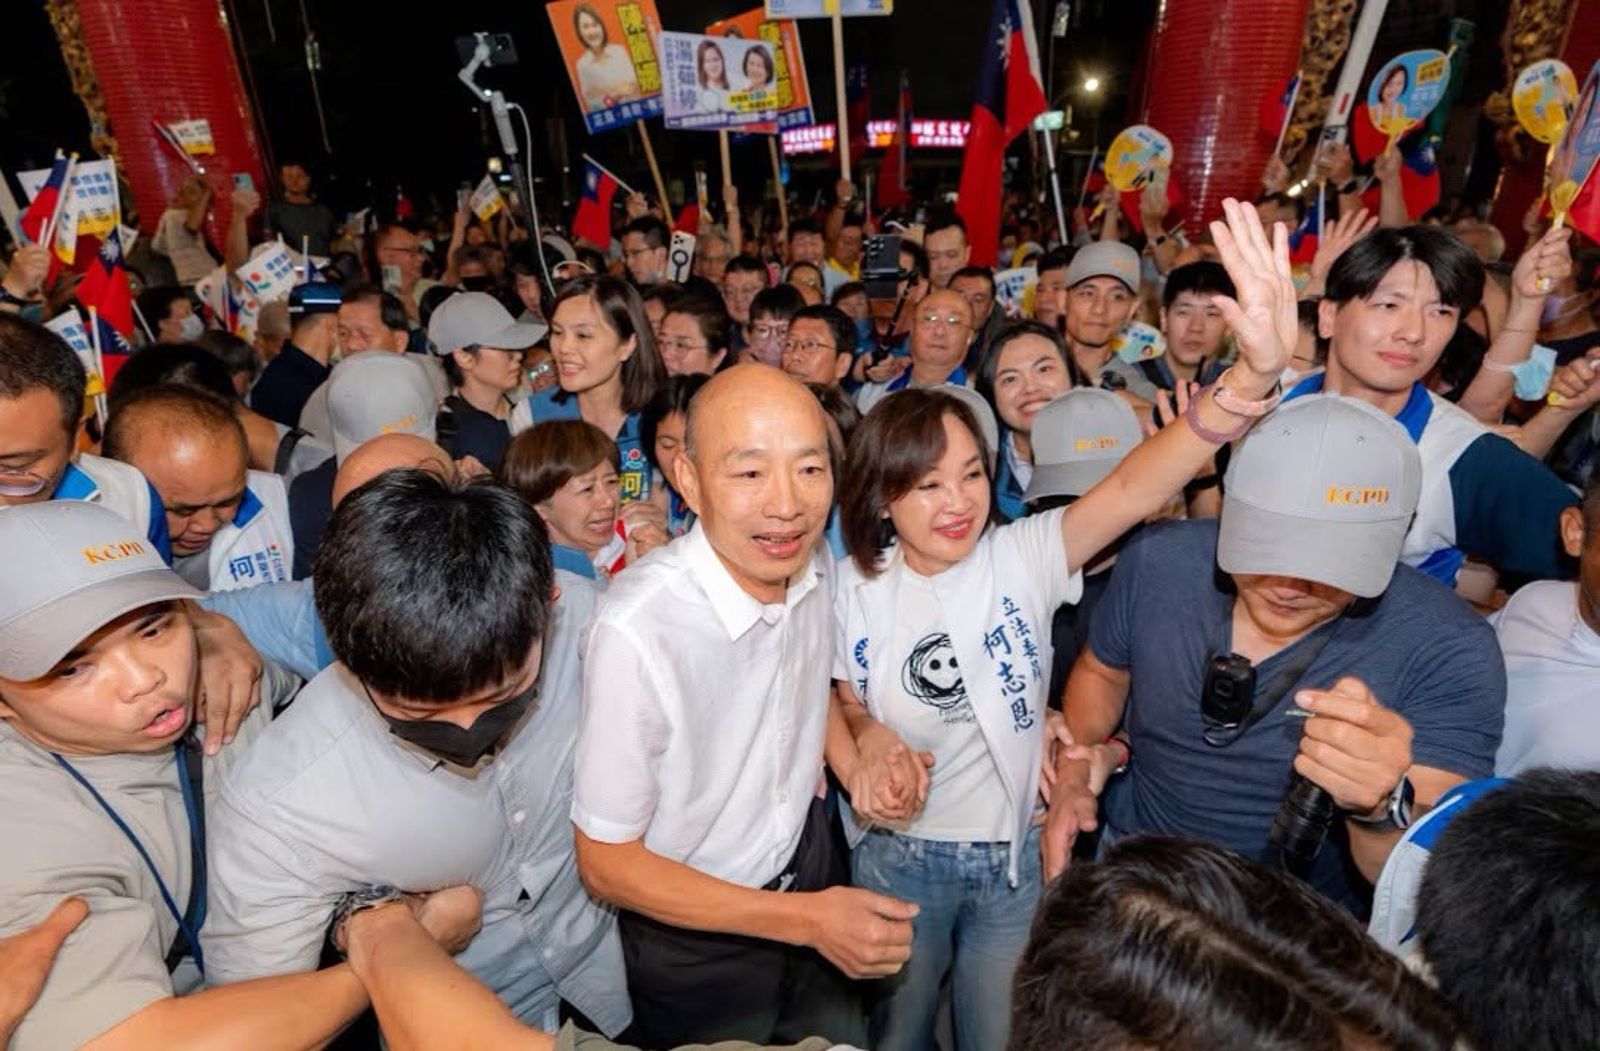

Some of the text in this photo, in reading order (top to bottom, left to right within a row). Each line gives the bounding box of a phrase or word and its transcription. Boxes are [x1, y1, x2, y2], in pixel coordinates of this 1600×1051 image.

[1325, 485, 1391, 506] KCPD
[82, 541, 145, 567] KCPD
[983, 624, 1034, 733] 柯志恩
